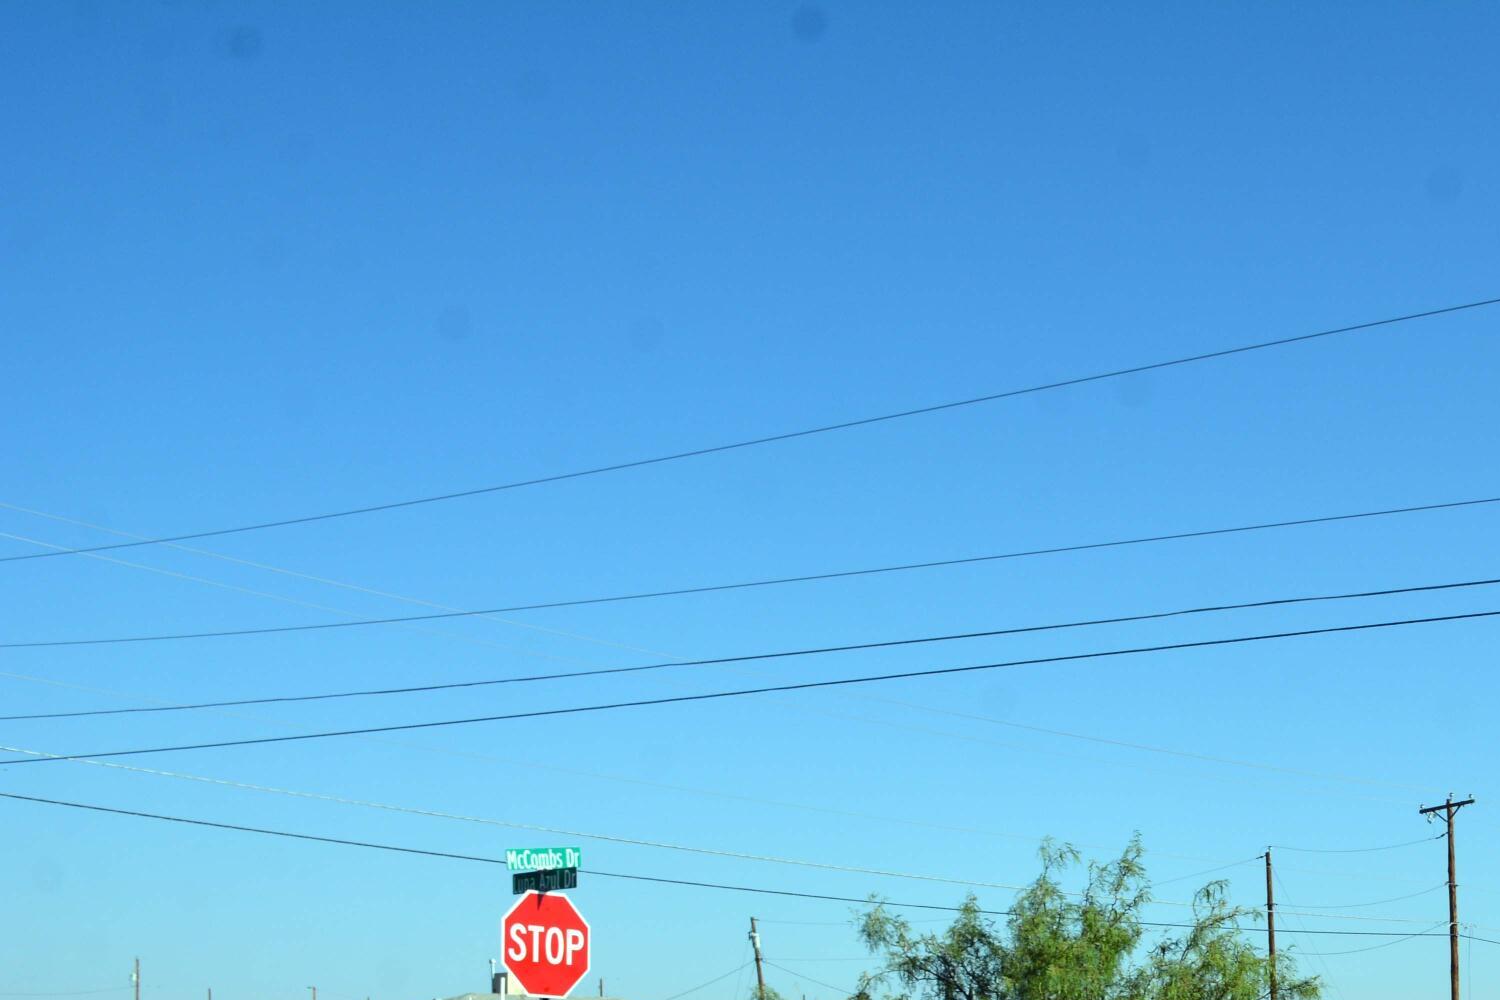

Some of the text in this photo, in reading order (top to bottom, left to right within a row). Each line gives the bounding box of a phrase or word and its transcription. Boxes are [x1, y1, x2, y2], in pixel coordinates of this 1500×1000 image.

[506, 848, 579, 869] McCombs Dr
[513, 870, 576, 893] Luna Azul Dr
[508, 922, 585, 966] STOP
